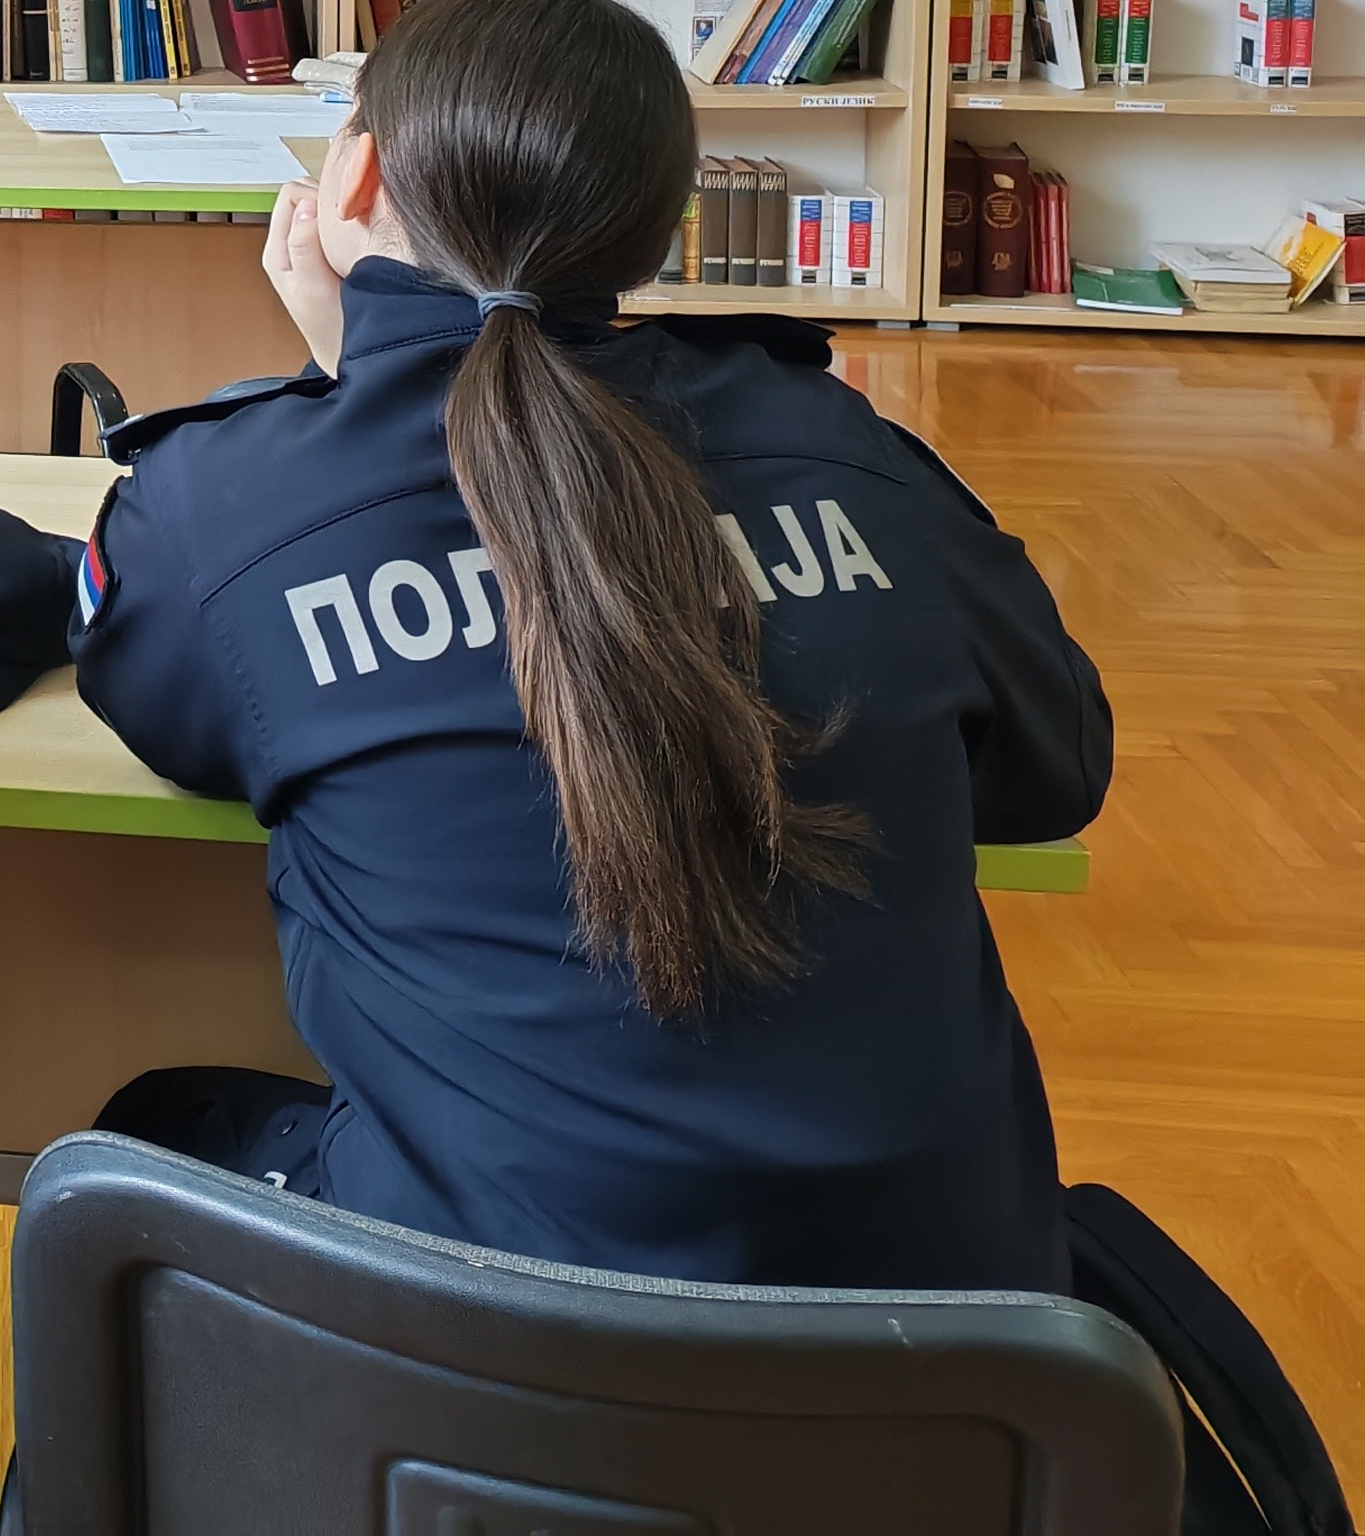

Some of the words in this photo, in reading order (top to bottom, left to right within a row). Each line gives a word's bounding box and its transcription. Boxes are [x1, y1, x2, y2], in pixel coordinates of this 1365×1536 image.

[802, 96, 839, 106] РУСКИ
[841, 96, 874, 106] ЈЕЗИК
[285, 499, 893, 686] ПОЛИЈА
